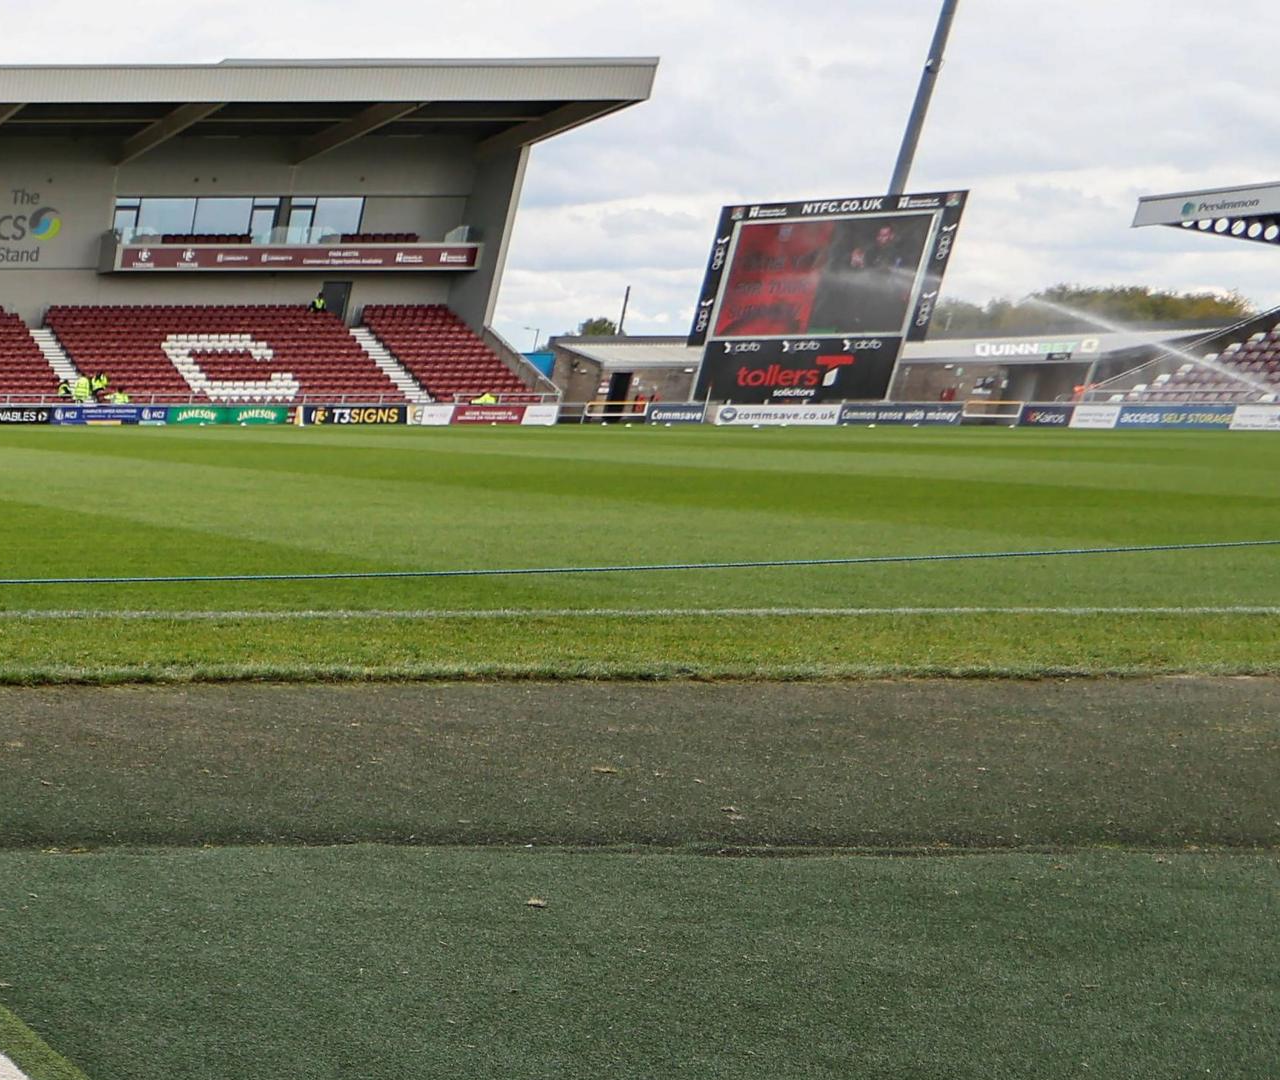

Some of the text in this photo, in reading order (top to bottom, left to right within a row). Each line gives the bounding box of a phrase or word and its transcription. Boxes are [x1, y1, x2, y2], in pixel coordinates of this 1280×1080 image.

[12, 190, 39, 205] The
[802, 199, 884, 214] NTFC.CO.UK
[1197, 198, 1260, 213] Persimmon
[736, 364, 820, 387] tollers
[772, 388, 816, 397] solicitors
[177, 408, 217, 421] JAMESON
[237, 408, 278, 421] JAMESON
[650, 409, 703, 421] Commsave
[738, 411, 835, 421] commsave.co.uk
[841, 409, 877, 420] Common
[878, 411, 903, 420] sense
[904, 410, 925, 420] with
[1160, 413, 1185, 424] SELF
